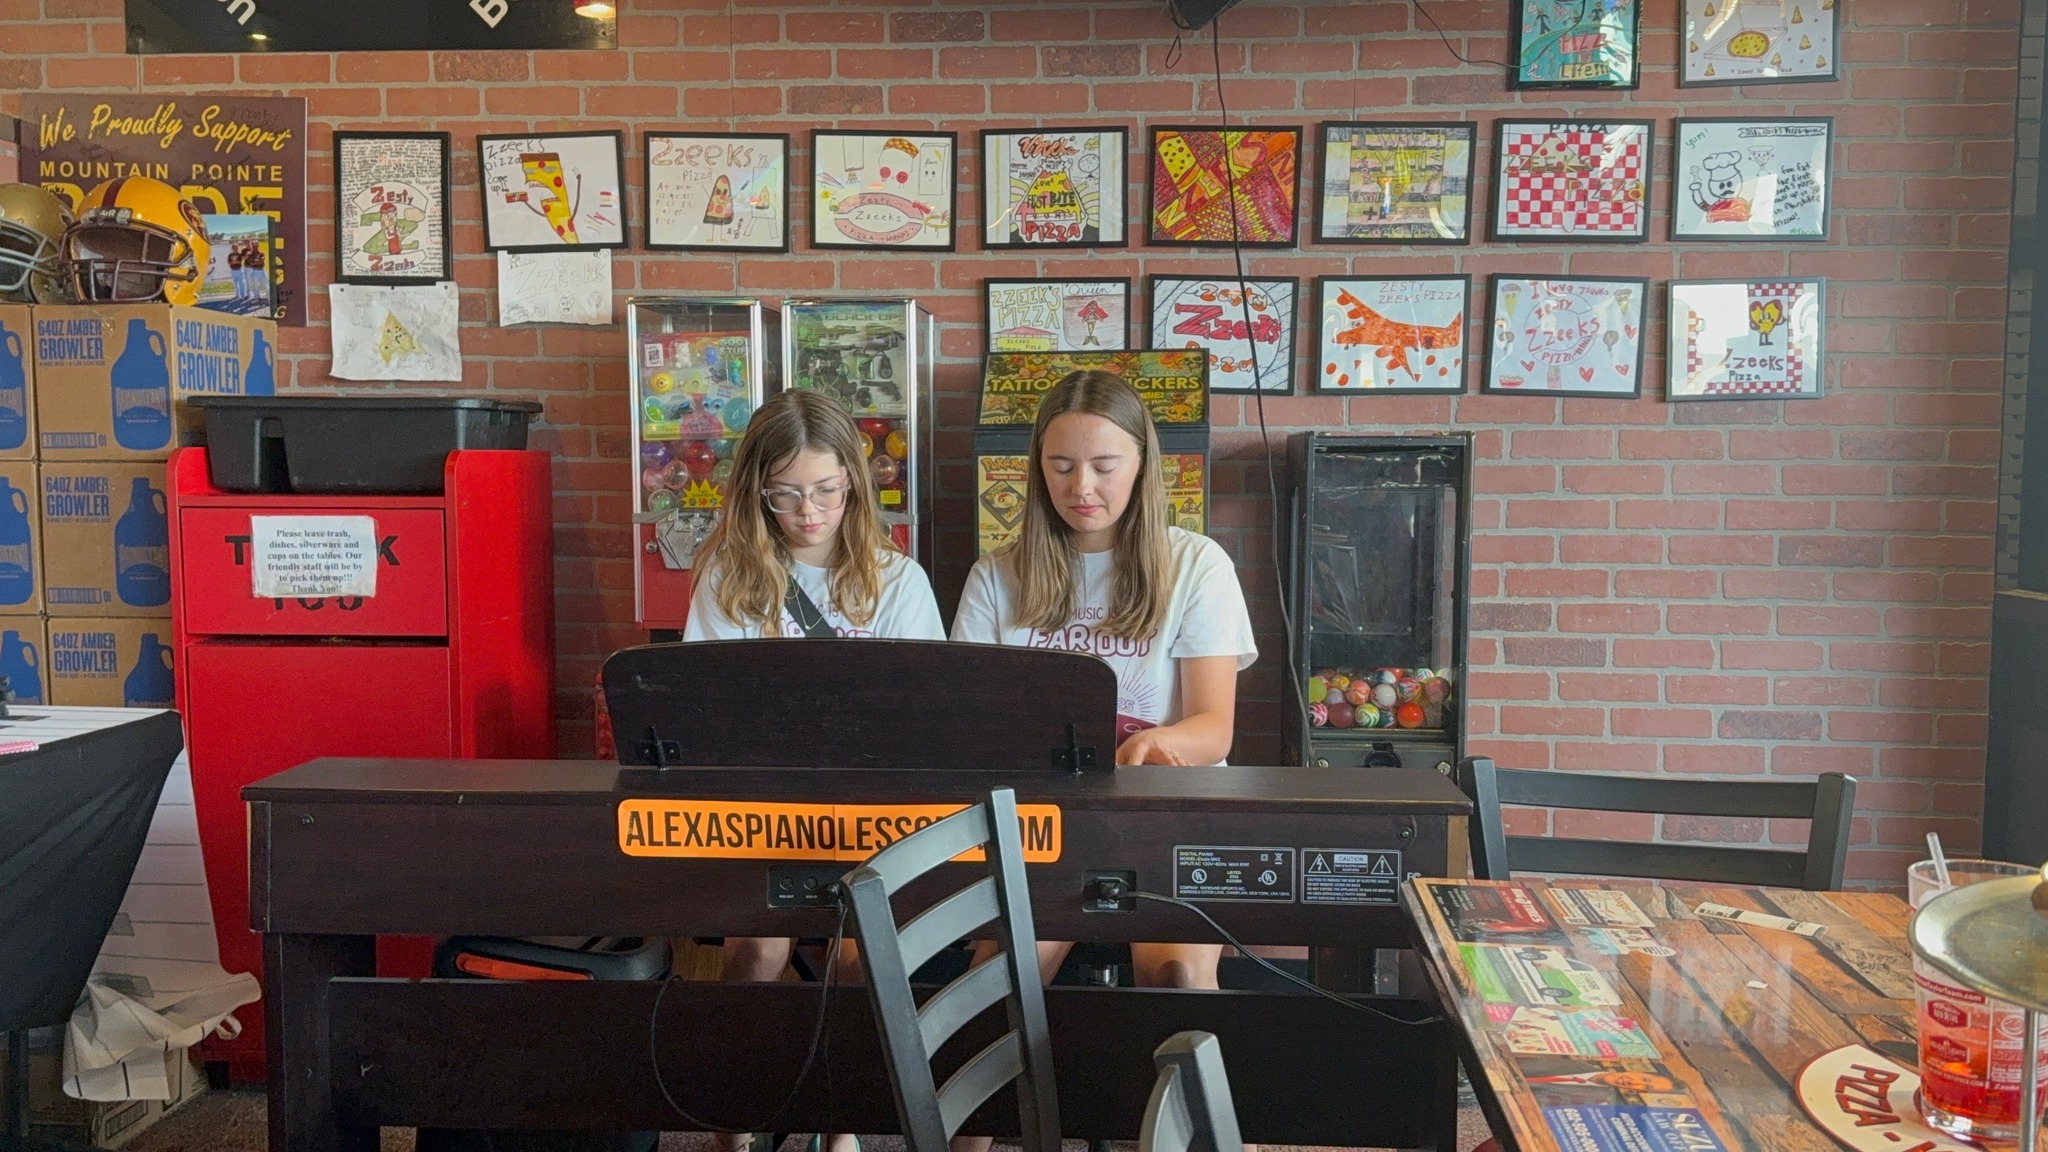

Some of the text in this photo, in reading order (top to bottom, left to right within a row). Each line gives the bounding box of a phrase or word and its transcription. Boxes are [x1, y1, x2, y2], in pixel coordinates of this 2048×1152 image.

[39, 102, 292, 154] We Proudly Support
[39, 160, 283, 182] MOUNTAIN POINTE
[1025, 221, 1081, 243] PIZZA
[1379, 281, 1425, 292] ZESTY
[1378, 289, 1461, 304] ZEEKS PIZZA
[997, 306, 1060, 330] PIZZA
[66, 319, 104, 337] AMBER
[205, 323, 240, 355] AMBER
[39, 337, 104, 361] GROWLER
[177, 351, 241, 395] GROWLER
[1133, 376, 1200, 390] ICKERS
[74, 477, 109, 494] AMBER
[46, 494, 110, 517] GROWLER
[276, 530, 352, 539] Please leave trash,
[269, 541, 297, 550] dishes,
[299, 541, 342, 549] silverware
[267, 553, 286, 561] cups
[268, 562, 300, 572] friendly
[302, 562, 323, 570] staff
[324, 562, 340, 570] will
[352, 563, 363, 572] by
[290, 574, 308, 584] pick
[310, 574, 331, 582] them
[332, 574, 354, 584] up!!!
[292, 585, 318, 593] Thank
[81, 633, 116, 650] AMBER
[1027, 624, 1091, 651] FAR
[54, 650, 118, 672] GROWLER
[1835, 1063, 1903, 1128] PIZZA
